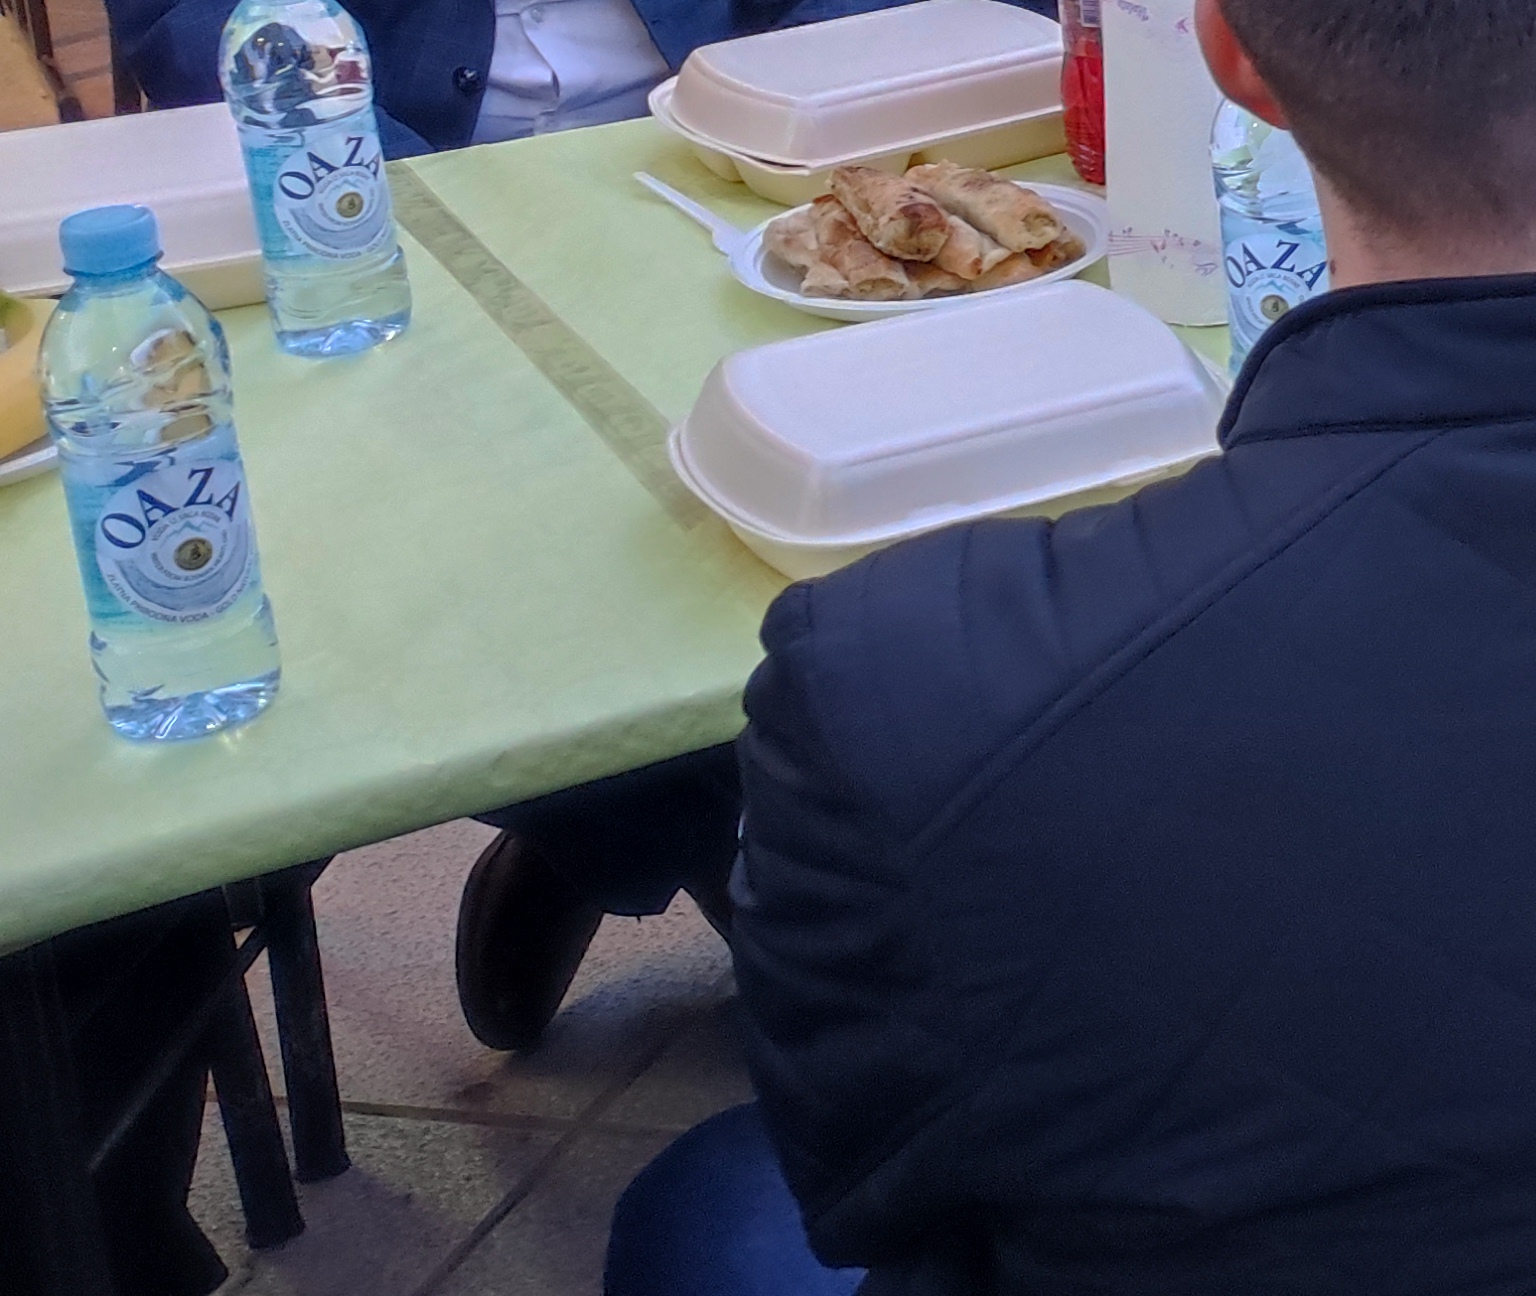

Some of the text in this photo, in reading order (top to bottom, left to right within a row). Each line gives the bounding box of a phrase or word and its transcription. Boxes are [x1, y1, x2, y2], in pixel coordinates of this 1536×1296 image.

[278, 136, 381, 201] OAZA
[1226, 238, 1328, 292] OAZA
[101, 467, 241, 549] OAZA
[180, 612, 209, 623] VODA
